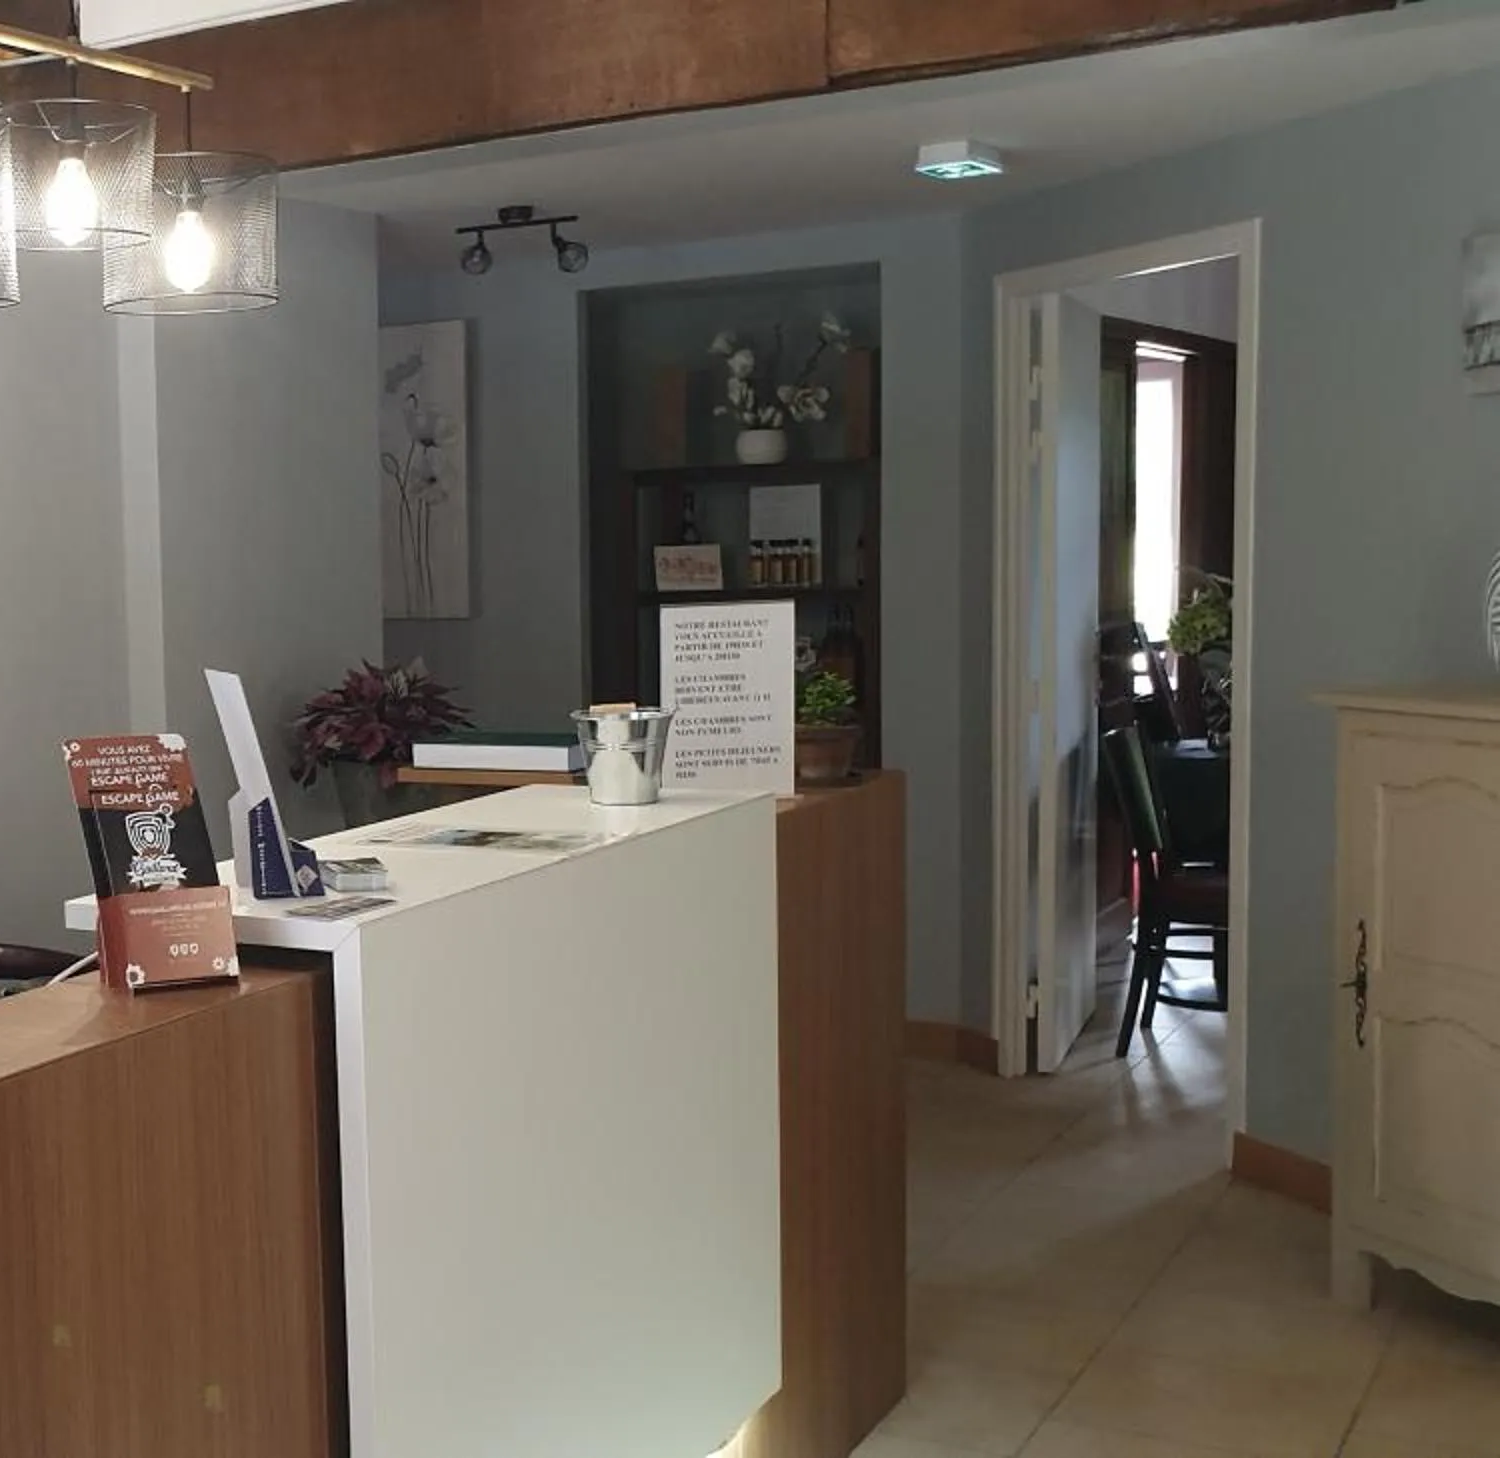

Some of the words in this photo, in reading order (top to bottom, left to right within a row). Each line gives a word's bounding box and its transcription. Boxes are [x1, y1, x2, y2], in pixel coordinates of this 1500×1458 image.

[97, 744, 125, 755] VOUS
[91, 773, 133, 787] ESCAPE
[135, 771, 169, 789] GAME
[101, 791, 144, 805] ESCAPE
[145, 789, 180, 808] GAME
